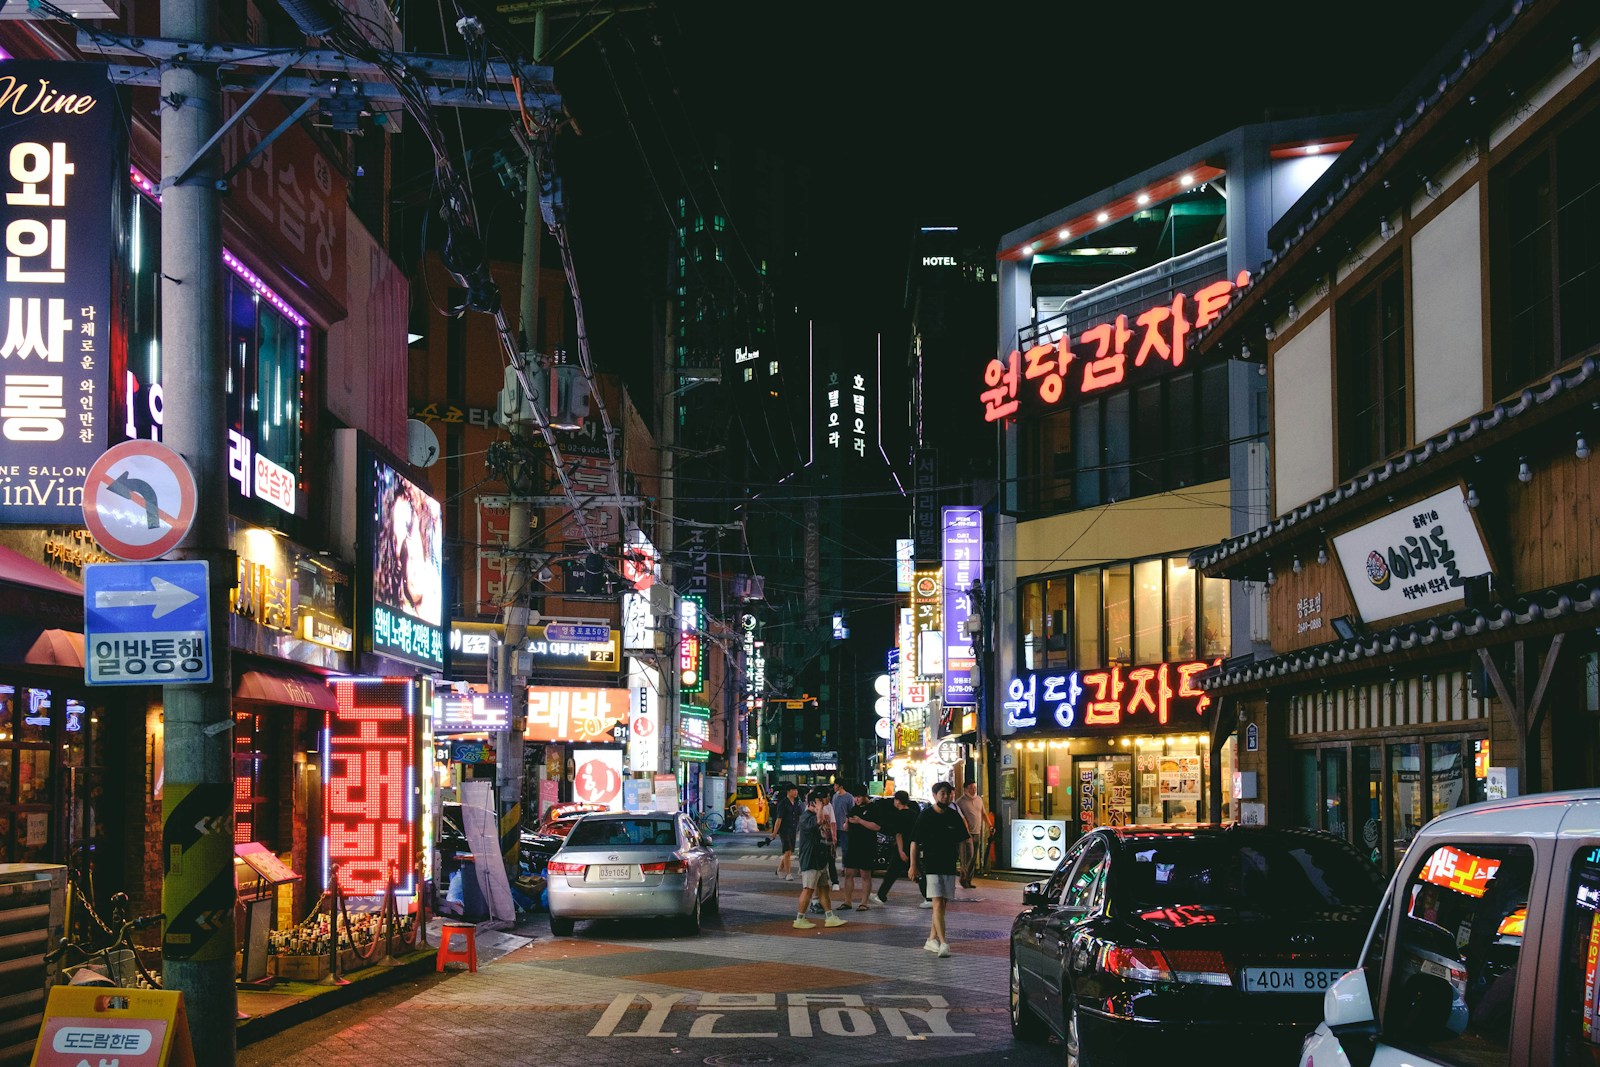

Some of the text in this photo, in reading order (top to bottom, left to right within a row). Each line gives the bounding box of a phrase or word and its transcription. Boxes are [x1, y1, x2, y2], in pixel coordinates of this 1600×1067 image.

[0, 76, 97, 116] Wine
[922, 256, 957, 266] HOTEL
[1, 142, 75, 442] 와인싸롱
[79, 307, 97, 443] 다채로운 와인만찬
[853, 374, 866, 457] 호텔오라
[29, 466, 86, 476] SALON
[257, 459, 293, 507] 연습장
[1297, 592, 1321, 619] 영등포점
[391, 615, 412, 654] 노래방
[561, 626, 609, 638] 영등포로50길
[96, 638, 203, 675] 일방통행
[596, 652, 610, 661] 2F
[283, 681, 316, 705] VinVin
[614, 727, 626, 739] B1
[437, 749, 449, 760] B1
[330, 680, 408, 894] 노래방
[1256, 970, 1349, 990] 40서 885
[64, 1031, 141, 1050] 도드람한돈
